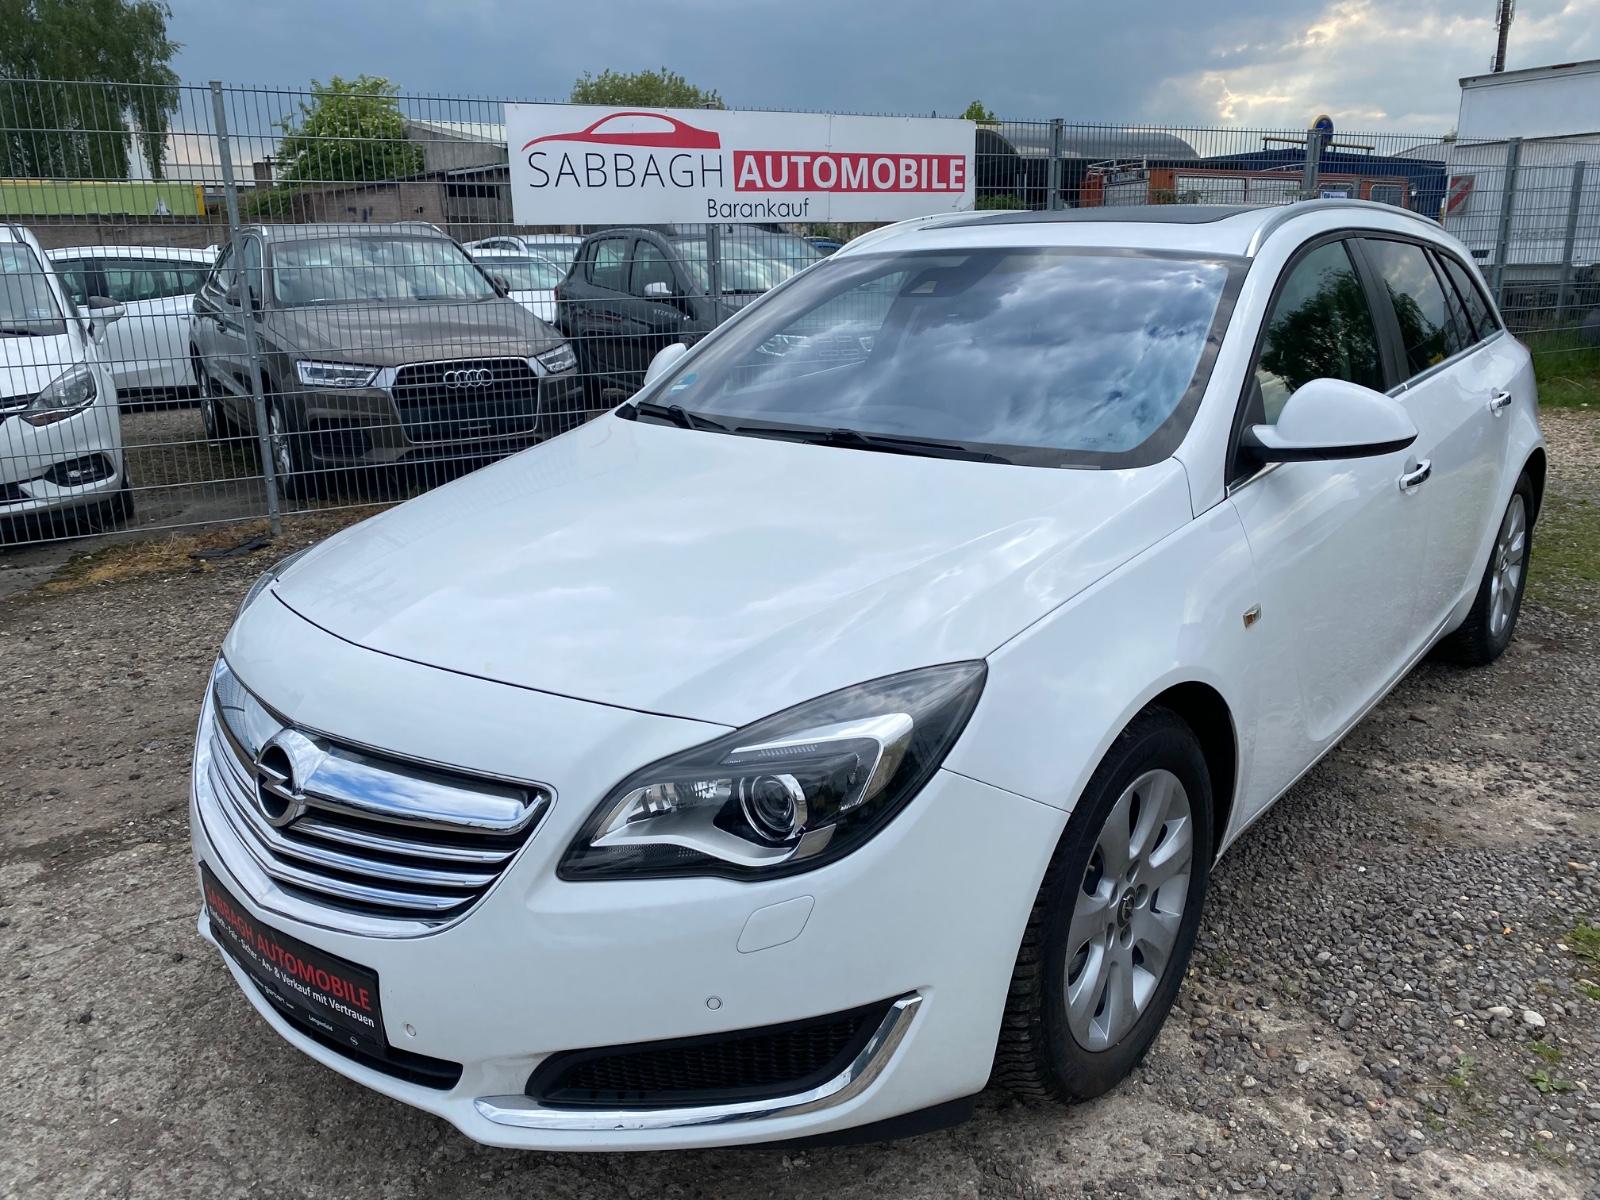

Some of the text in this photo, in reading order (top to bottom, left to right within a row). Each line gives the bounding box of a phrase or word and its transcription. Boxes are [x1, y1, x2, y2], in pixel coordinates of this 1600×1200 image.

[528, 151, 965, 191] SABBAGH AUTOMOBILE
[707, 198, 809, 218] Barankauf
[257, 933, 372, 1012] AUTOMOBILE
[280, 971, 311, 996] Verkauf
[312, 991, 328, 1006] mit
[328, 997, 375, 1028] Vertrauen
